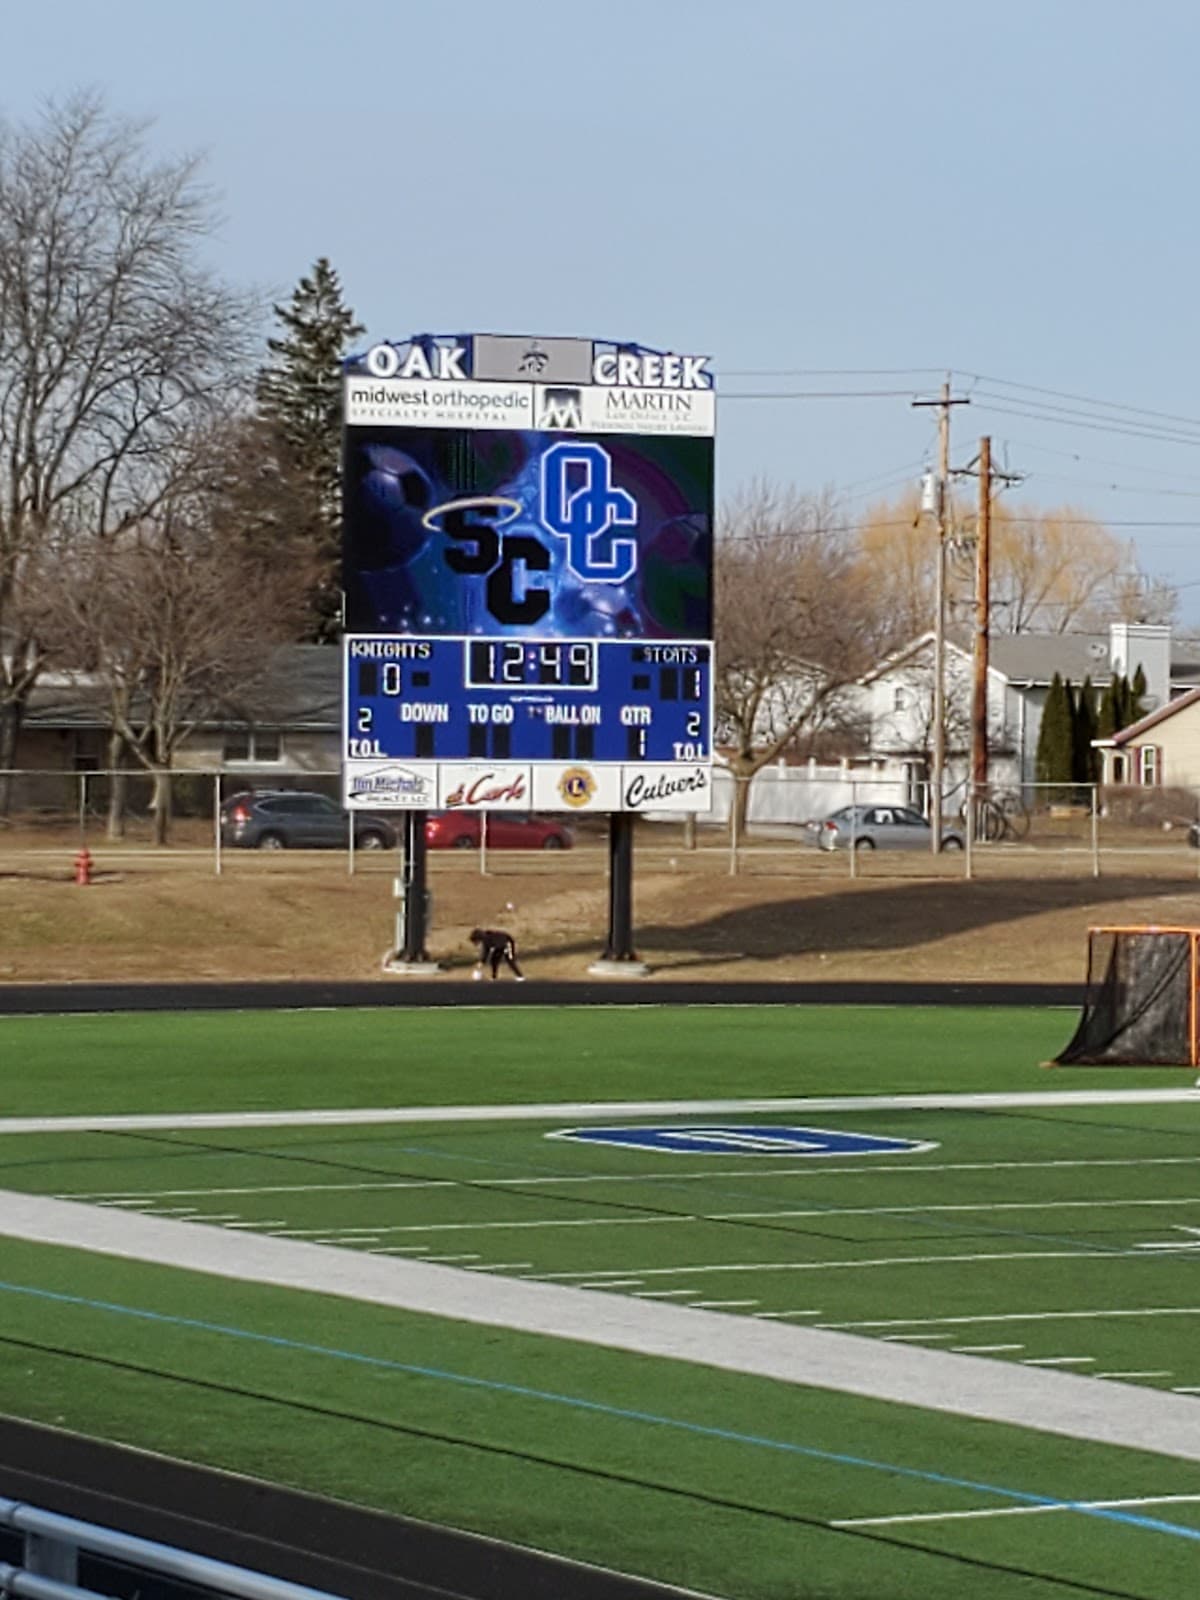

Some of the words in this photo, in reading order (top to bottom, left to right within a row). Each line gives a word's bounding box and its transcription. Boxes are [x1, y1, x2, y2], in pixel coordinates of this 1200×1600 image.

[367, 344, 467, 379] OAK
[593, 354, 710, 389] CREEK
[352, 386, 429, 405] midwest
[432, 389, 529, 410] orthopedic
[607, 390, 692, 411] MARTIN
[351, 641, 431, 659] KNIGHTS
[488, 643, 590, 682] 12:49
[383, 663, 400, 695] 0
[357, 707, 373, 733] 2
[401, 703, 449, 722] DOWN
[467, 704, 489, 724] TO
[491, 704, 514, 724] GO
[545, 705, 580, 725] BALL
[581, 705, 601, 725] ON
[621, 706, 651, 726] QTR
[686, 711, 701, 737] 2
[625, 768, 706, 808] Culver's
